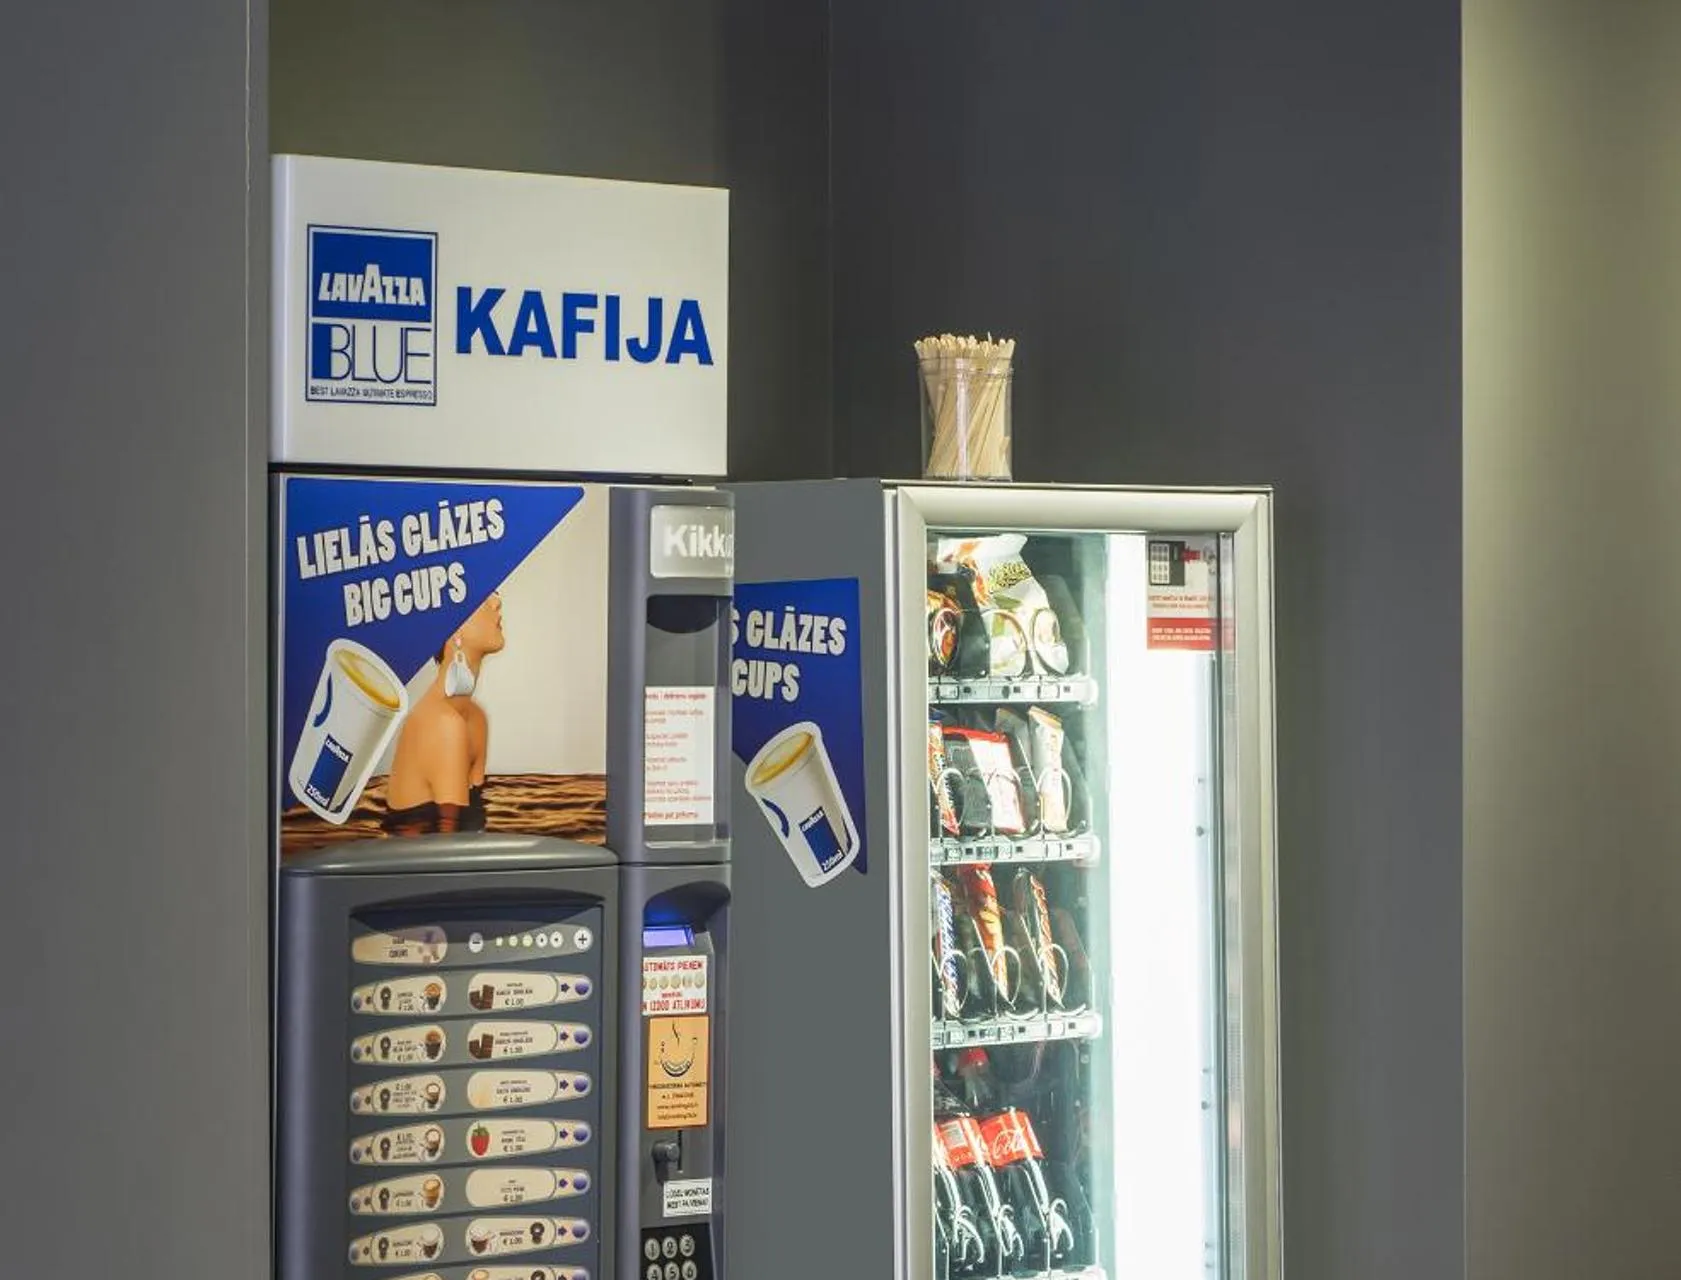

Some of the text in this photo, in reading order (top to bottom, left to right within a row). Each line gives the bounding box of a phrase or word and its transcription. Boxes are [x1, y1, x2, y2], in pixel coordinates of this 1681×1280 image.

[318, 263, 426, 307] LAVAZZA
[312, 323, 432, 385] BLUE
[455, 286, 714, 366] KAFIJA
[297, 498, 505, 580] LIELĀS GLĀZES
[343, 562, 466, 627] BIG CUPS
[746, 605, 847, 656] GLĀZES
[731, 658, 800, 702] CUPS
